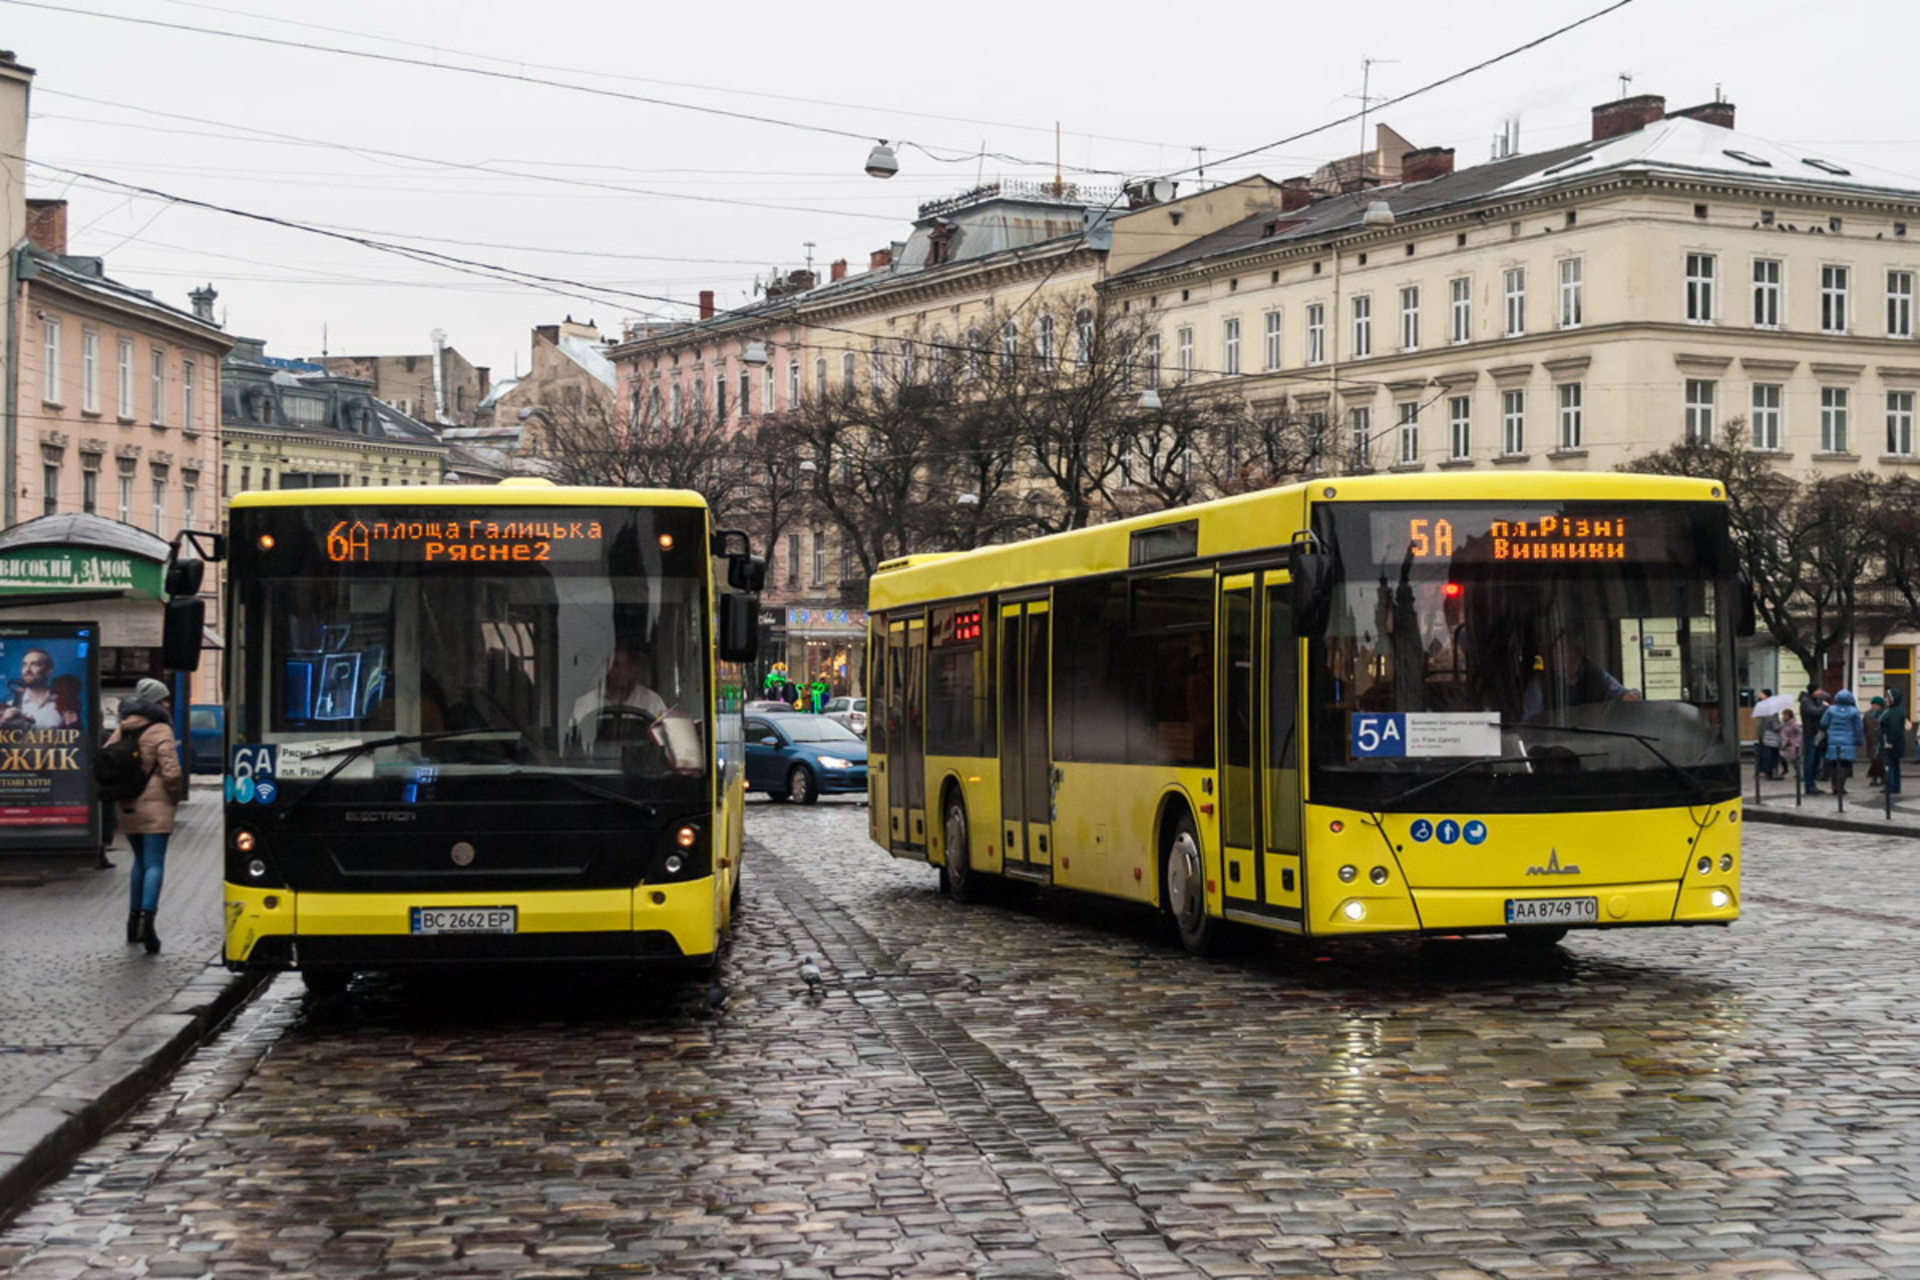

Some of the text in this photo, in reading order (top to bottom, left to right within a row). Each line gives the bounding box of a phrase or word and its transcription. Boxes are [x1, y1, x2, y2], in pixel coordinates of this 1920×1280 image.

[373, 520, 602, 540] площа Галицька
[425, 542, 551, 561] Рясне2
[1494, 538, 1624, 559] Винники
[0, 555, 132, 581] ВИСОКИЙ ЗАМОК
[0, 748, 81, 770] ЖИК
[1539, 901, 1571, 917] 8749
[449, 913, 484, 928] 2662
